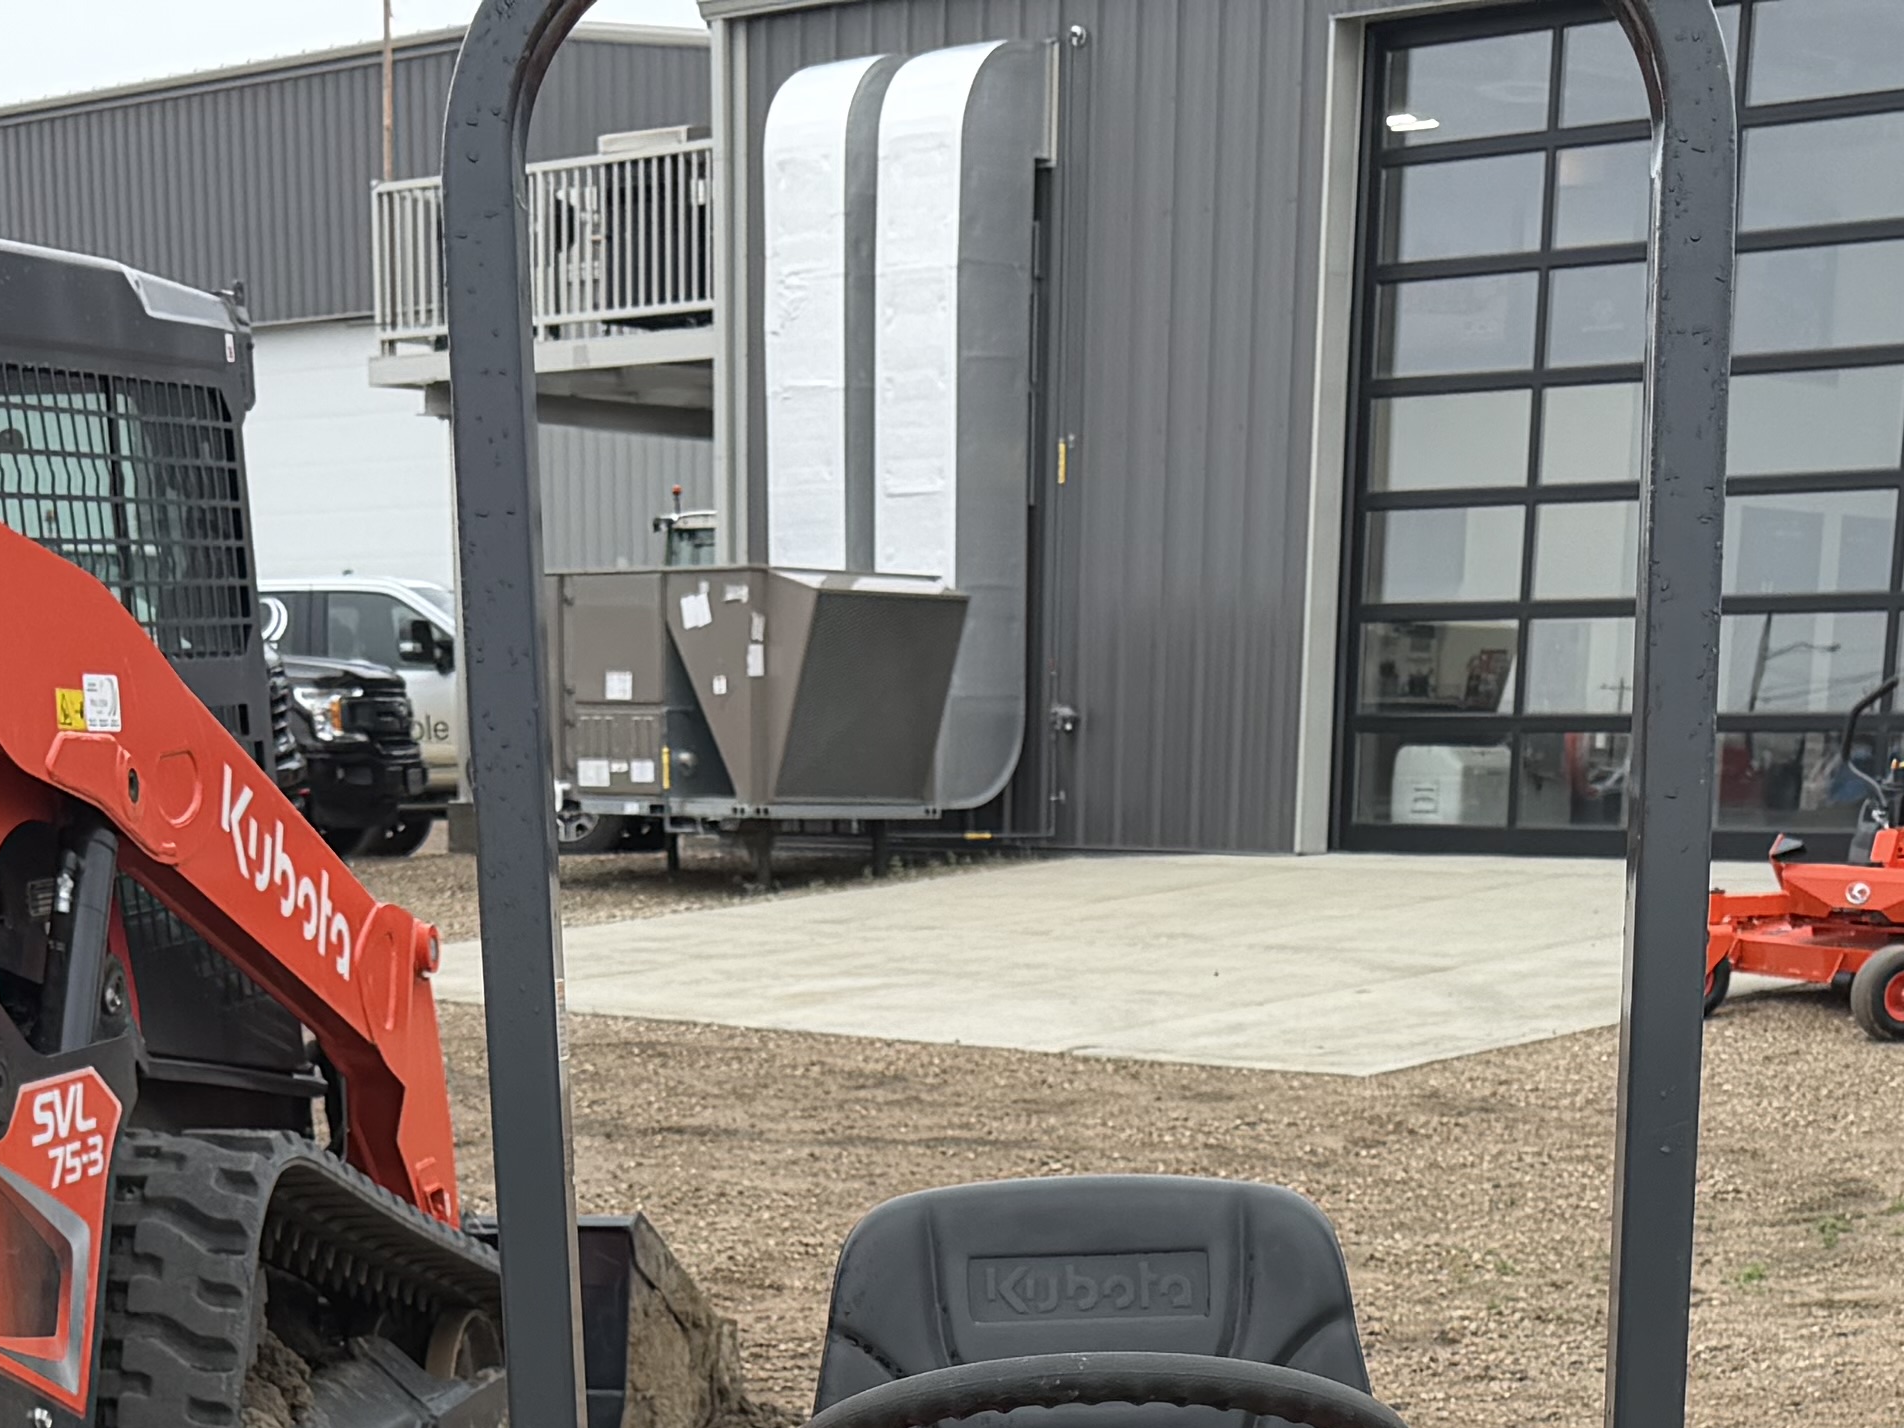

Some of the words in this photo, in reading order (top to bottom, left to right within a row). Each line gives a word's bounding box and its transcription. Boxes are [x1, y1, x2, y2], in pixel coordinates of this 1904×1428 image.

[220, 763, 351, 981] Kubota
[31, 1084, 97, 1146] SVL
[47, 1133, 104, 1189] 75-3
[985, 1260, 1193, 1315] Kubota
